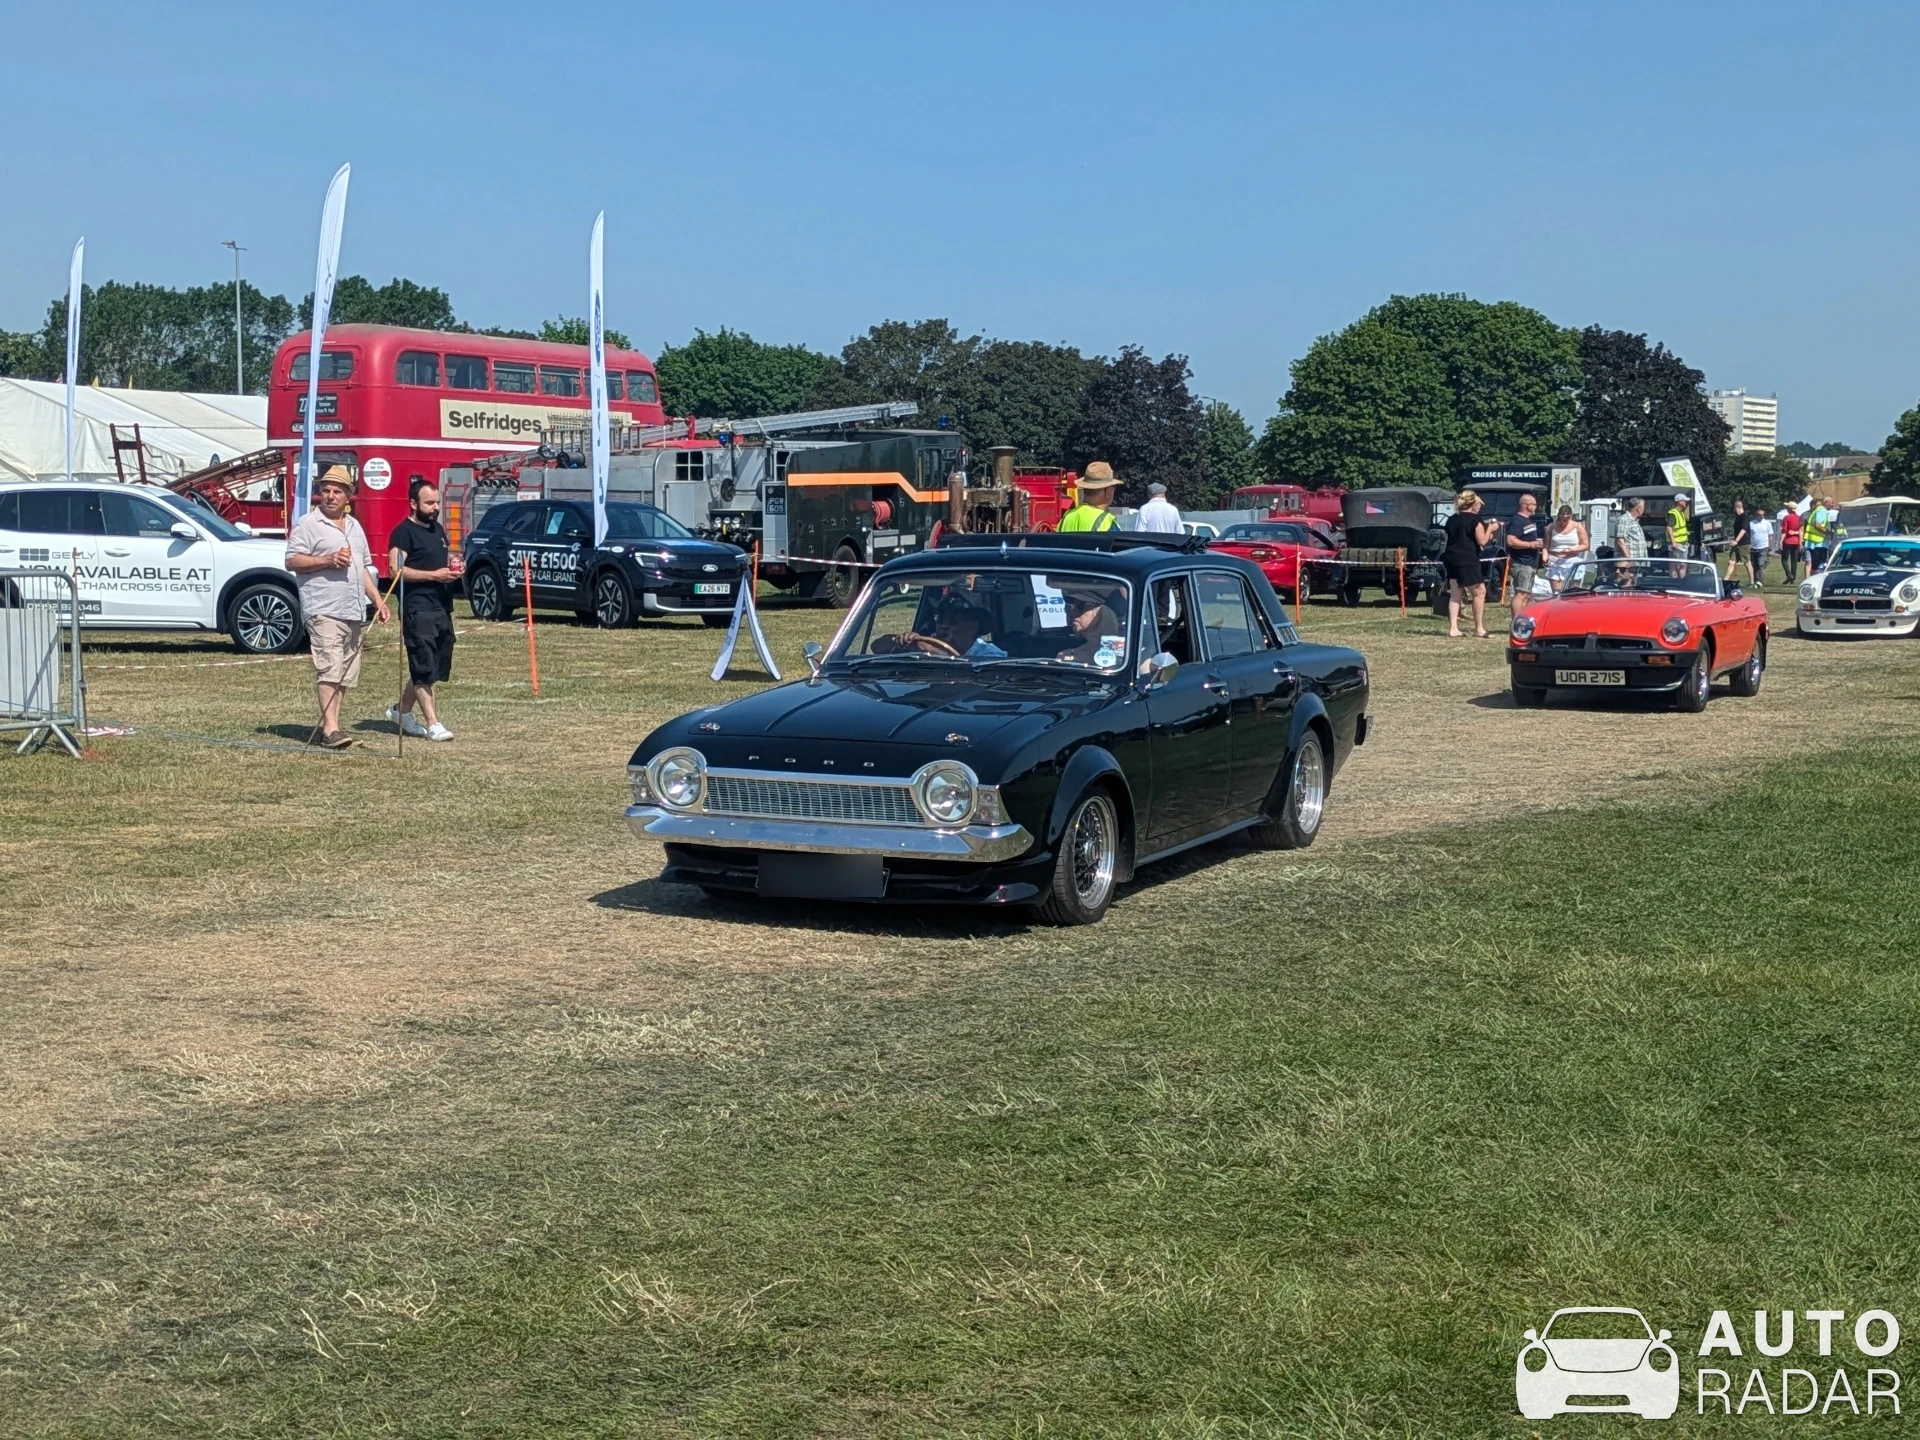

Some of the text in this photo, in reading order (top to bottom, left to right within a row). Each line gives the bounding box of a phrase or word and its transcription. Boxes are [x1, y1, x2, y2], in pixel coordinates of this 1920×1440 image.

[317, 423, 342, 431] SERVICE
[449, 410, 542, 435] Selfridges
[508, 549, 538, 568] SAVE
[72, 566, 181, 580] AVAILABLE
[186, 568, 211, 581] AT
[507, 567, 526, 579] FORD
[537, 570, 551, 581] CAR
[552, 571, 577, 582] GRANT
[54, 581, 118, 591] WTHAM
[120, 582, 162, 591] CROSS
[170, 583, 211, 592] GATES
[699, 584, 715, 592] EA26
[1852, 587, 1876, 595] 528L
[1590, 672, 1621, 683] 271S
